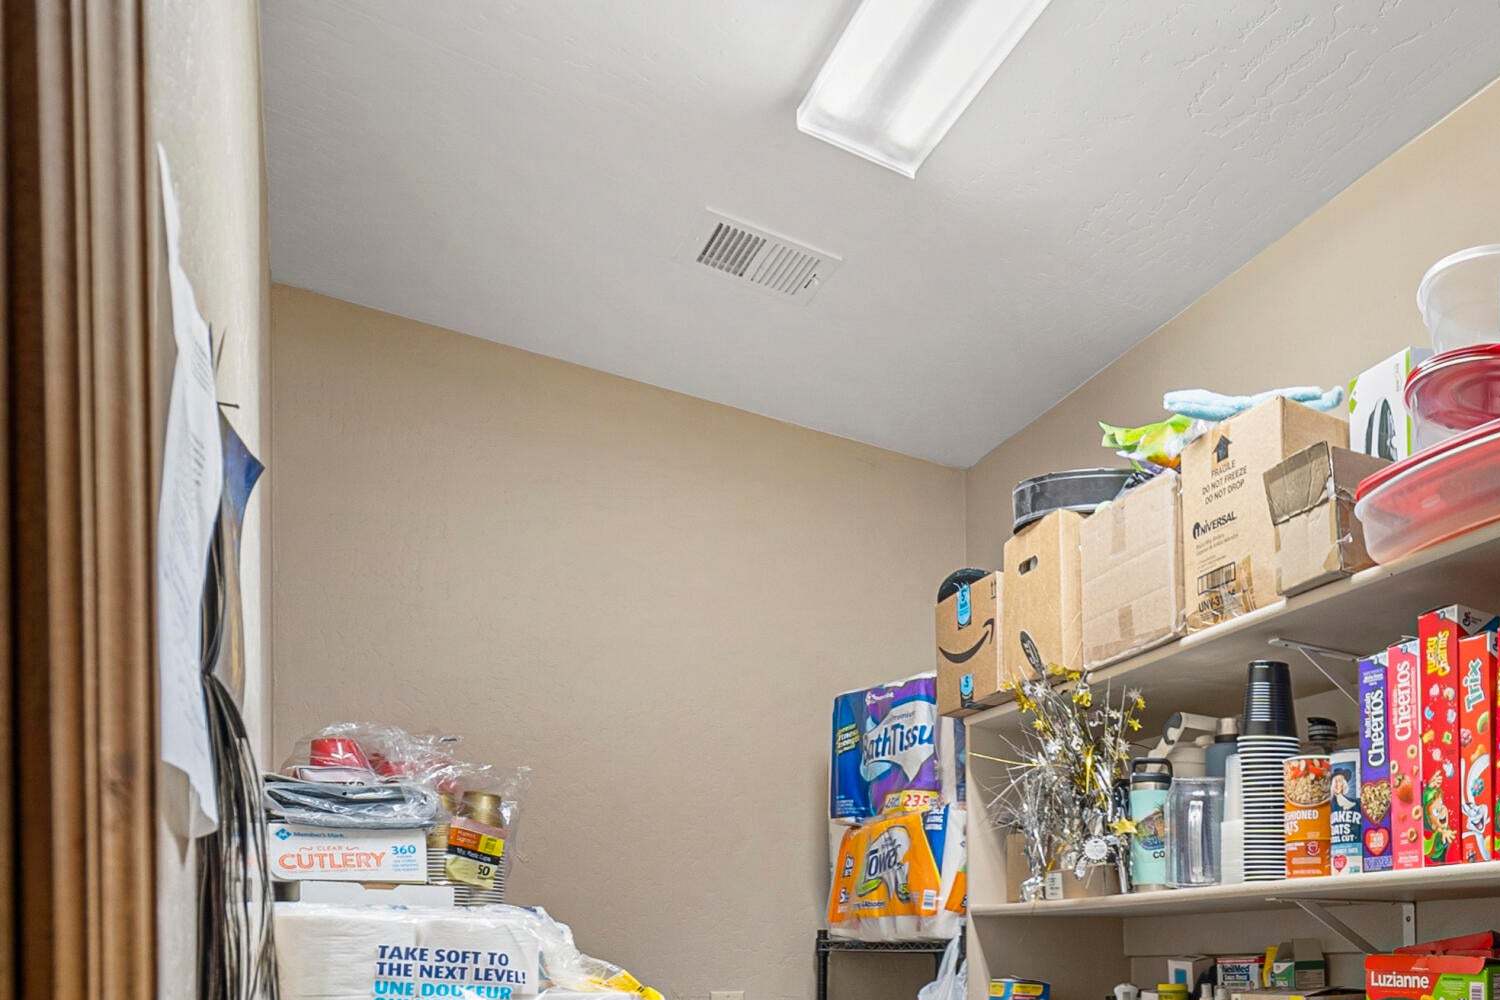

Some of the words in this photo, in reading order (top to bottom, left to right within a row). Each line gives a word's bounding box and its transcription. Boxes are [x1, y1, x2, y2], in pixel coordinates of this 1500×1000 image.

[1211, 460, 1235, 477] FRAGILE
[1203, 485, 1210, 495] DO
[1211, 478, 1223, 490] NOT
[1225, 466, 1247, 484] FREEZE
[1205, 495, 1214, 504] DO
[1215, 489, 1226, 499] NOT
[1228, 479, 1245, 494] DROP
[1427, 637, 1438, 675] Lucky
[1437, 629, 1449, 677] Charms
[1465, 658, 1484, 712] Trix
[1396, 660, 1411, 741] Cheerios
[1368, 689, 1385, 768] Cheerios
[904, 793, 928, 807] 235
[278, 851, 385, 870] CUTLERY
[391, 845, 417, 855] 360
[477, 864, 490, 876] 50
[379, 945, 429, 961] TAKE
[435, 949, 481, 964] SOFT
[488, 952, 509, 966] TO
[377, 962, 413, 977] THE
[419, 965, 468, 980] NEXT
[474, 968, 526, 984] LEVEL!
[1370, 971, 1429, 989] Luzianne
[374, 981, 414, 995] UNE
